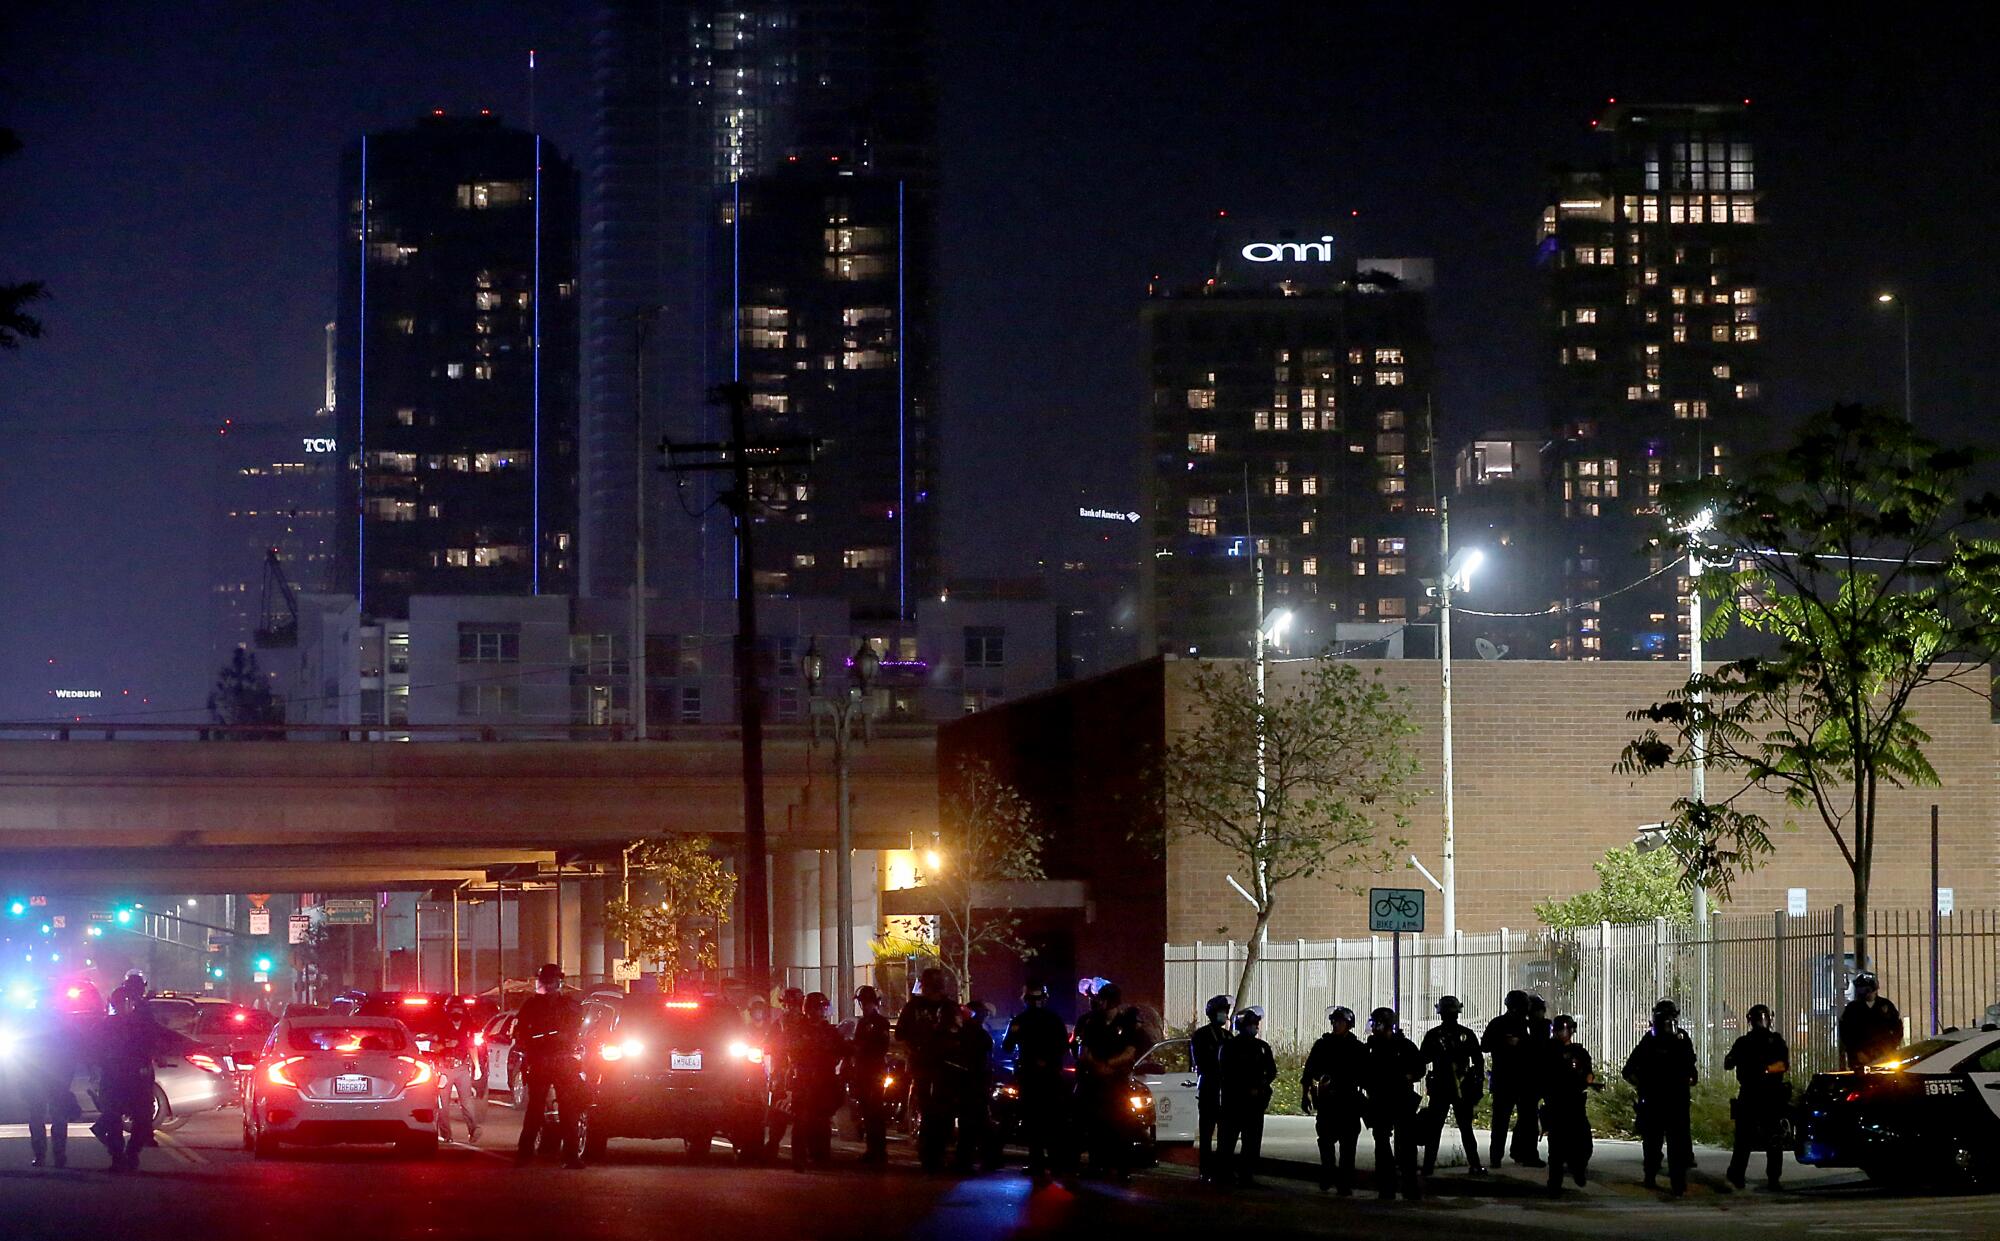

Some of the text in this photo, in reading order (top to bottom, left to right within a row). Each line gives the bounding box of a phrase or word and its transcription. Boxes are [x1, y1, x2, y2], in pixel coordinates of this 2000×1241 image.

[1242, 236, 1334, 262] onni
[1080, 507, 1125, 520] Bank of America
[1376, 920, 1393, 929] BIKE
